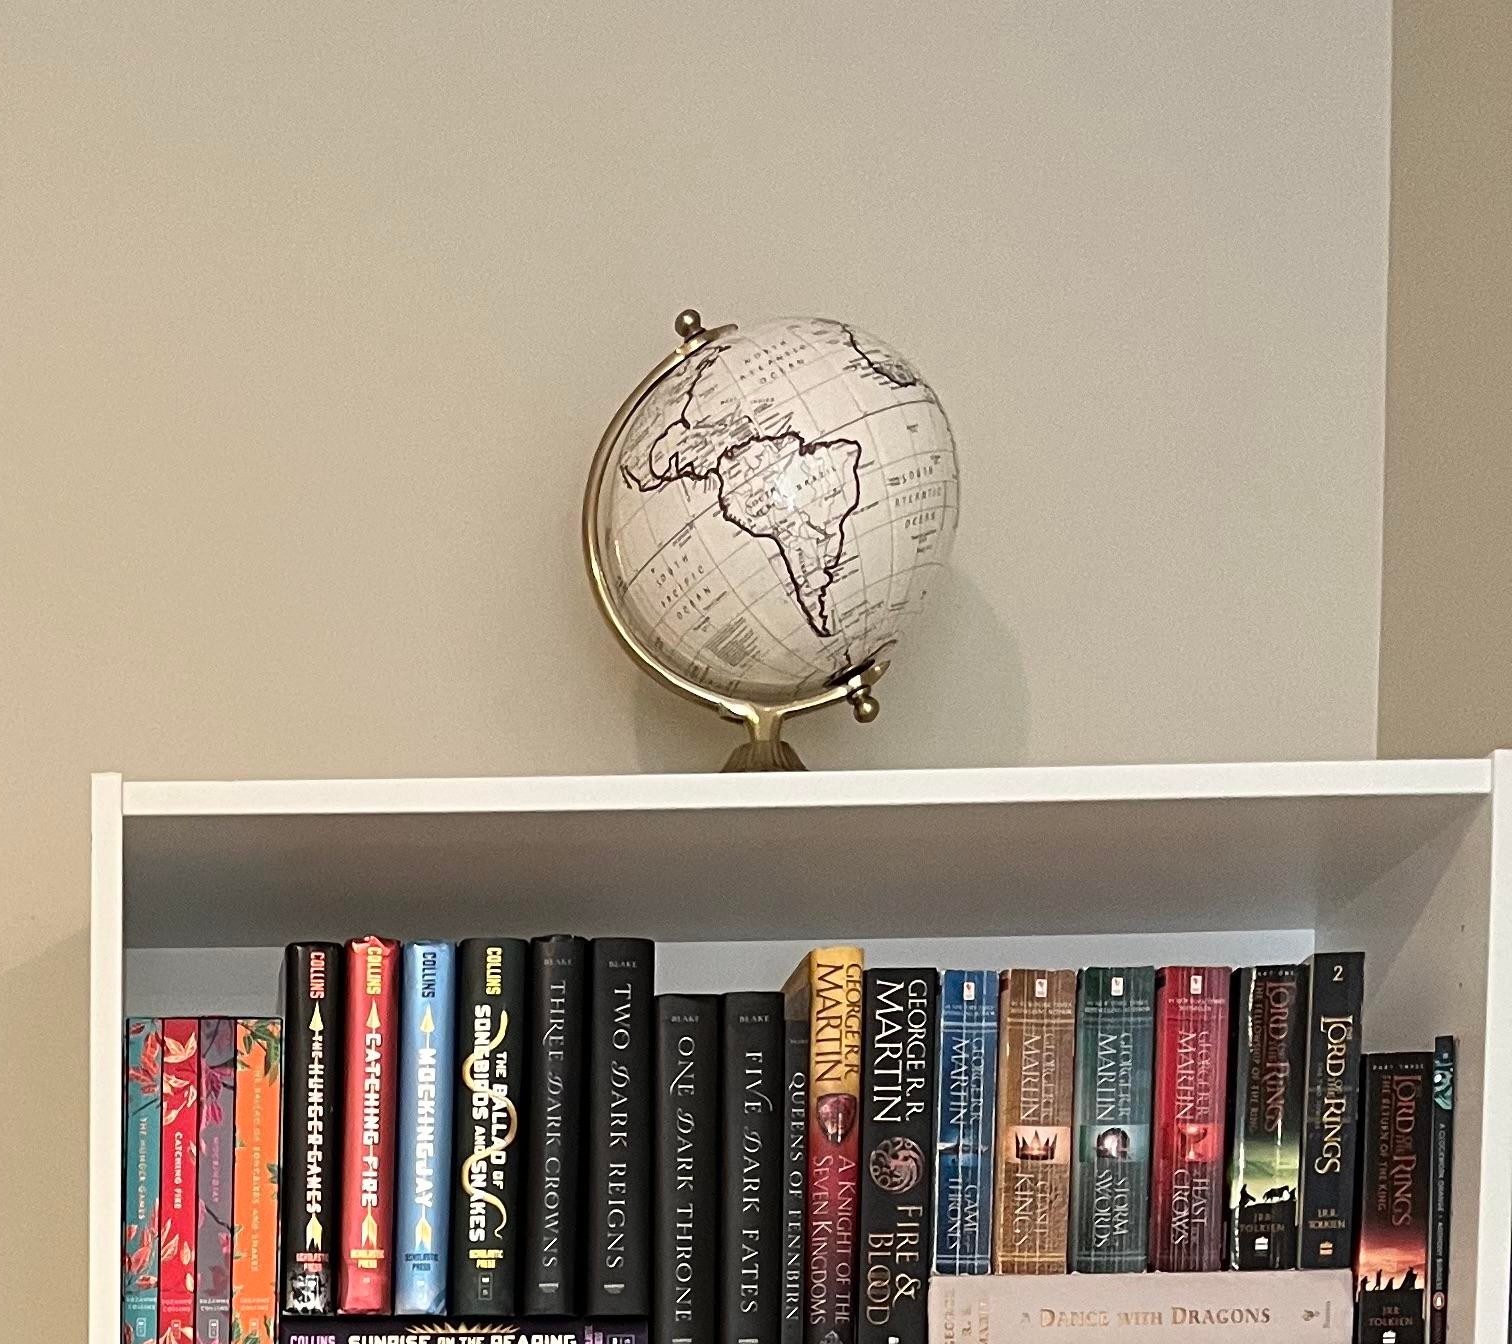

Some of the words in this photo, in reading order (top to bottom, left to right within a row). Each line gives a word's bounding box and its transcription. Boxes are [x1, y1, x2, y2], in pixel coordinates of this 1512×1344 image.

[310, 951, 325, 999] COLLINS
[486, 947, 502, 995] COLLINS
[1333, 966, 1343, 981] 2
[545, 981, 566, 1063] THREE
[874, 979, 904, 1122] MARTIN
[907, 979, 927, 1072] GEORGE
[416, 1048, 436, 1207] MOCKINGJAY
[546, 1066, 564, 1151] DARK
[544, 1157, 560, 1268] CROWNS
[896, 1205, 923, 1264] FIRE
[866, 1234, 891, 1326] BLOOD
[892, 1274, 921, 1308] &
[1040, 1307, 1109, 1327] DANCE
[1118, 1311, 1163, 1326] WITH
[1171, 1307, 1271, 1326] DRAGONS
